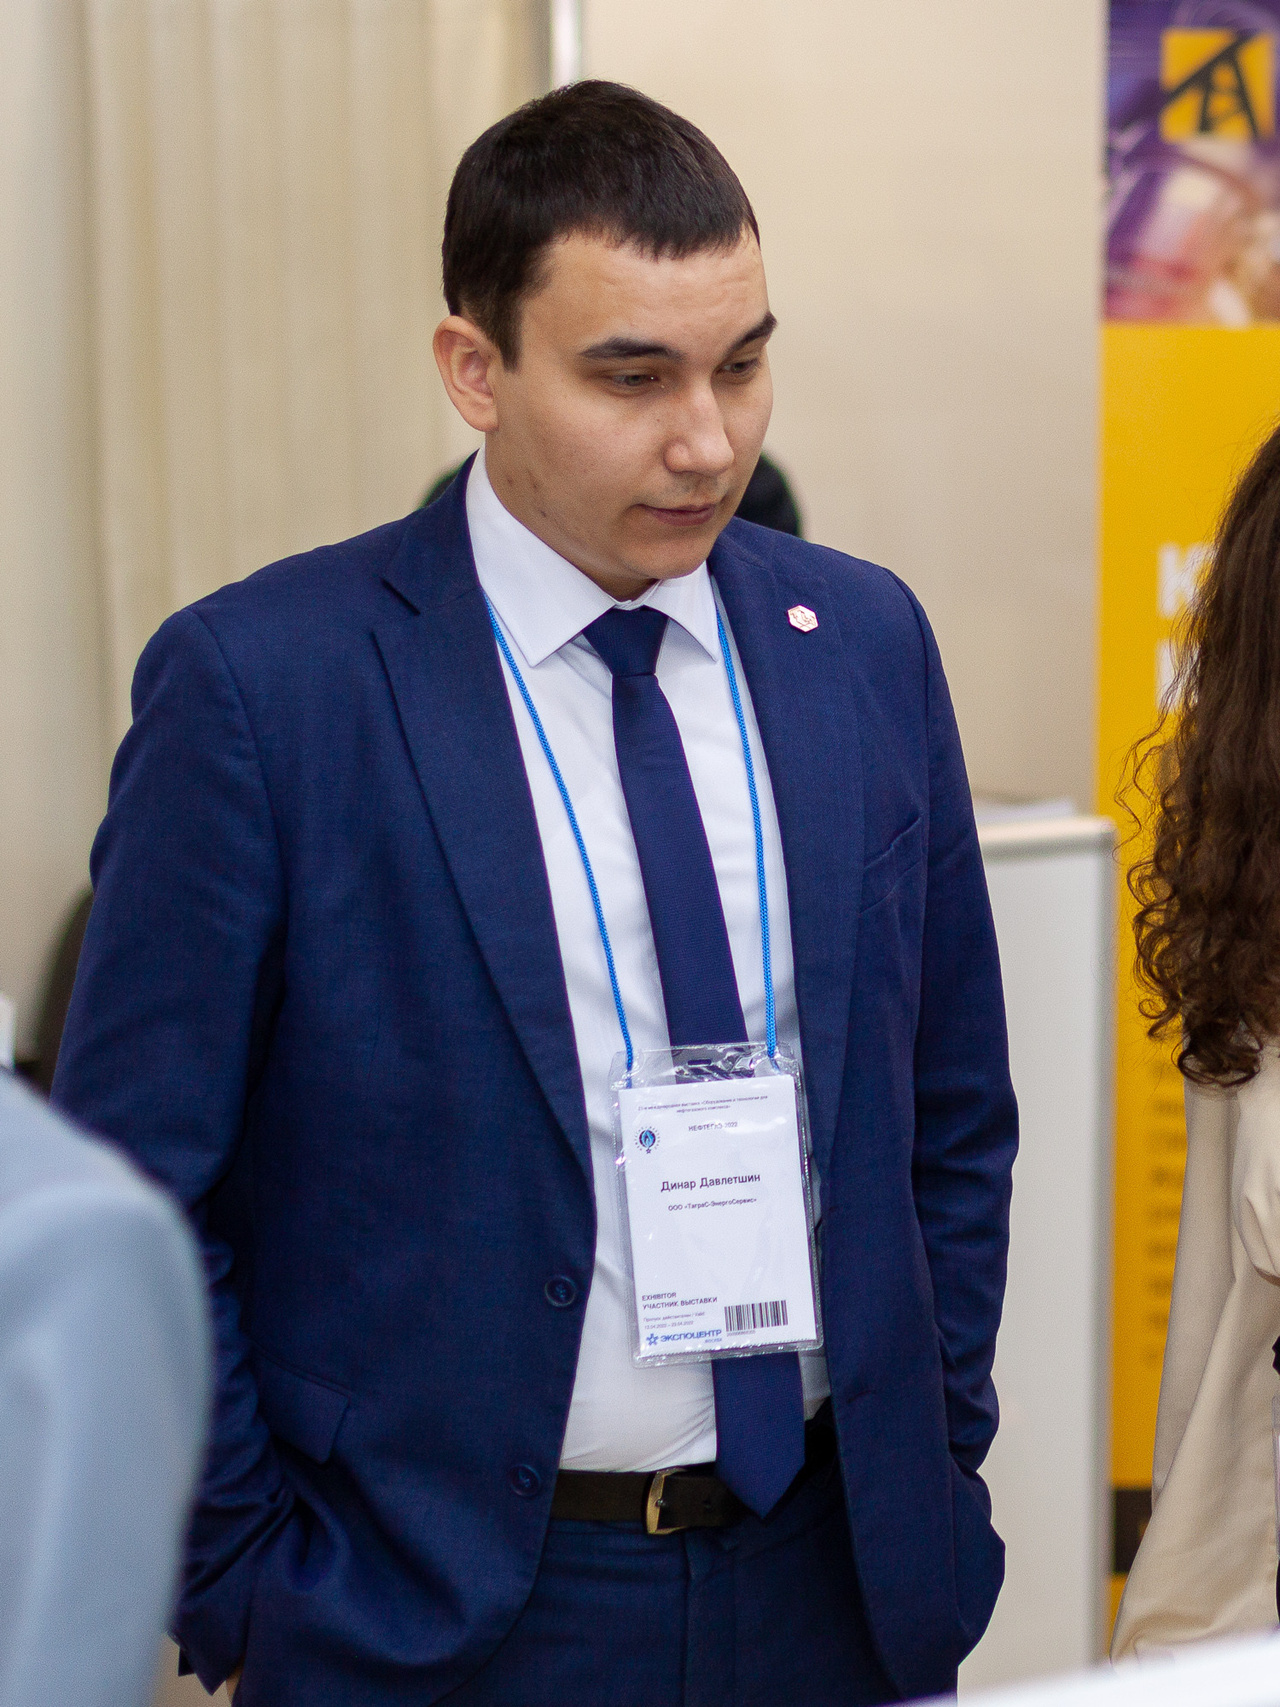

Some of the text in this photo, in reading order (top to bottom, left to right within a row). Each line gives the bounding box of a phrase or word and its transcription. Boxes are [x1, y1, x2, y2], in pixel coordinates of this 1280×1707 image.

[660, 1174, 761, 1193] Динар Давлетшин
[642, 1292, 677, 1302] EXHIBITOR
[643, 1297, 718, 1310] УЧАСТНИК ВЫСТАВКИ
[660, 1329, 722, 1342] ЭКСПОЦЕНТР
